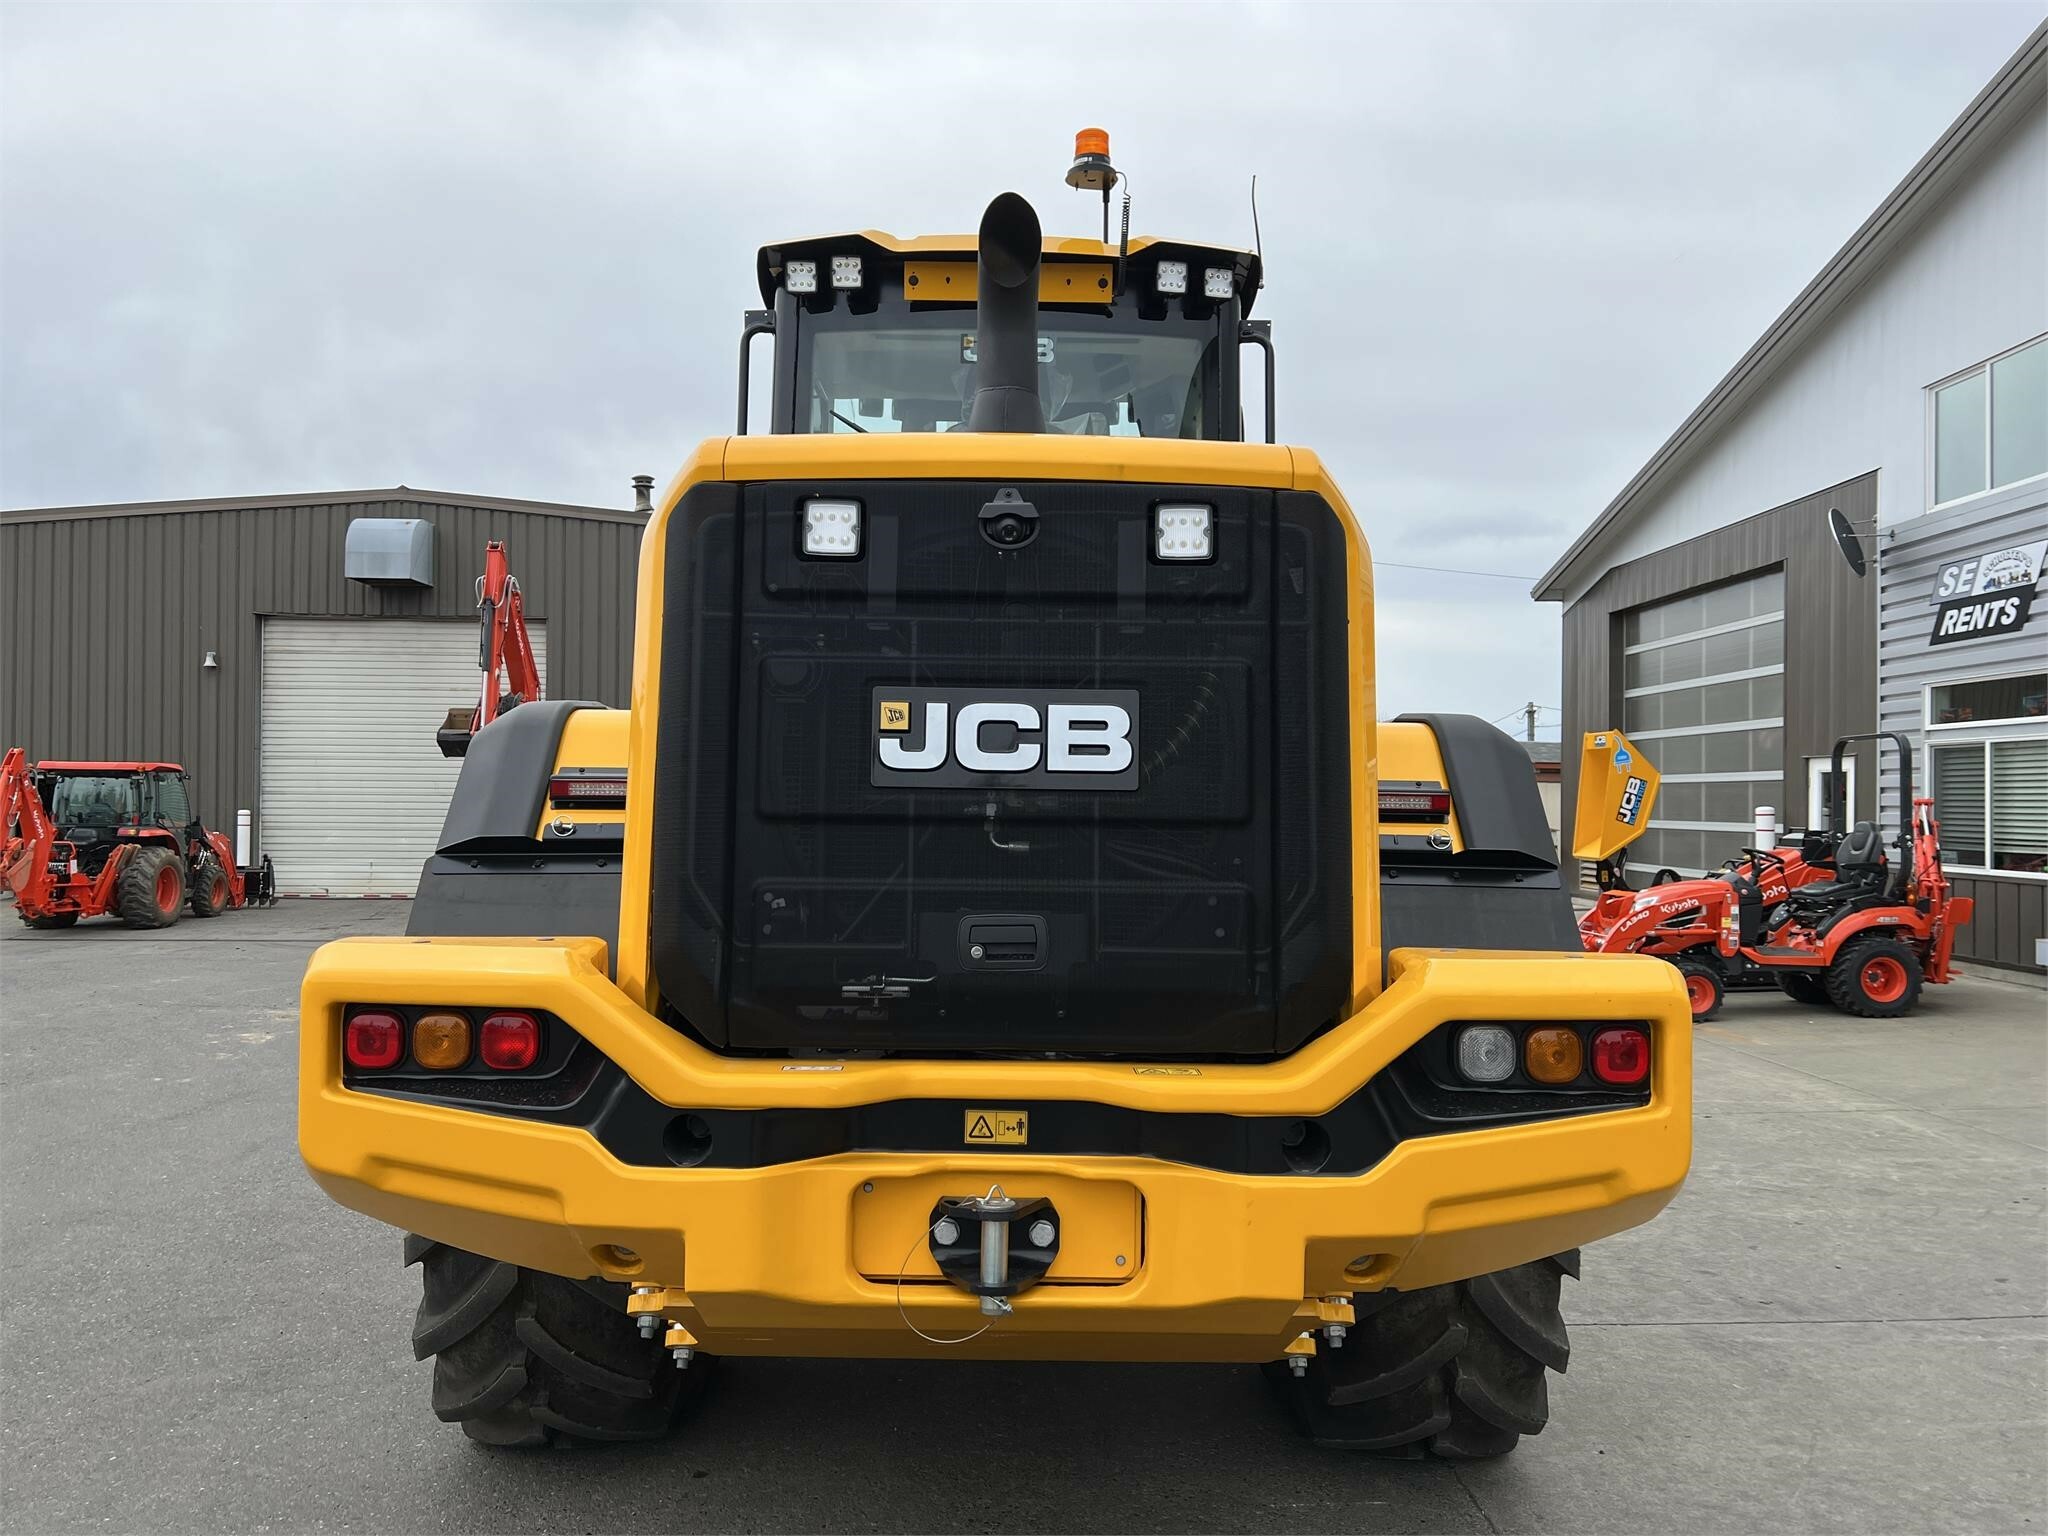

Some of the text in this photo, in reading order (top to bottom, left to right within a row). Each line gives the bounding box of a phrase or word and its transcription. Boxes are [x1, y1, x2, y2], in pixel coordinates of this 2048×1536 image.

[1939, 561, 1979, 597] SE
[1939, 596, 2020, 636] RENTS
[888, 709, 905, 722] JCB
[879, 702, 1133, 772] JCB
[1619, 777, 1641, 823] JCB
[1629, 780, 1647, 824] ELECTRIC
[1620, 909, 1650, 932] LA340
[1660, 898, 1699, 914] Kubota
